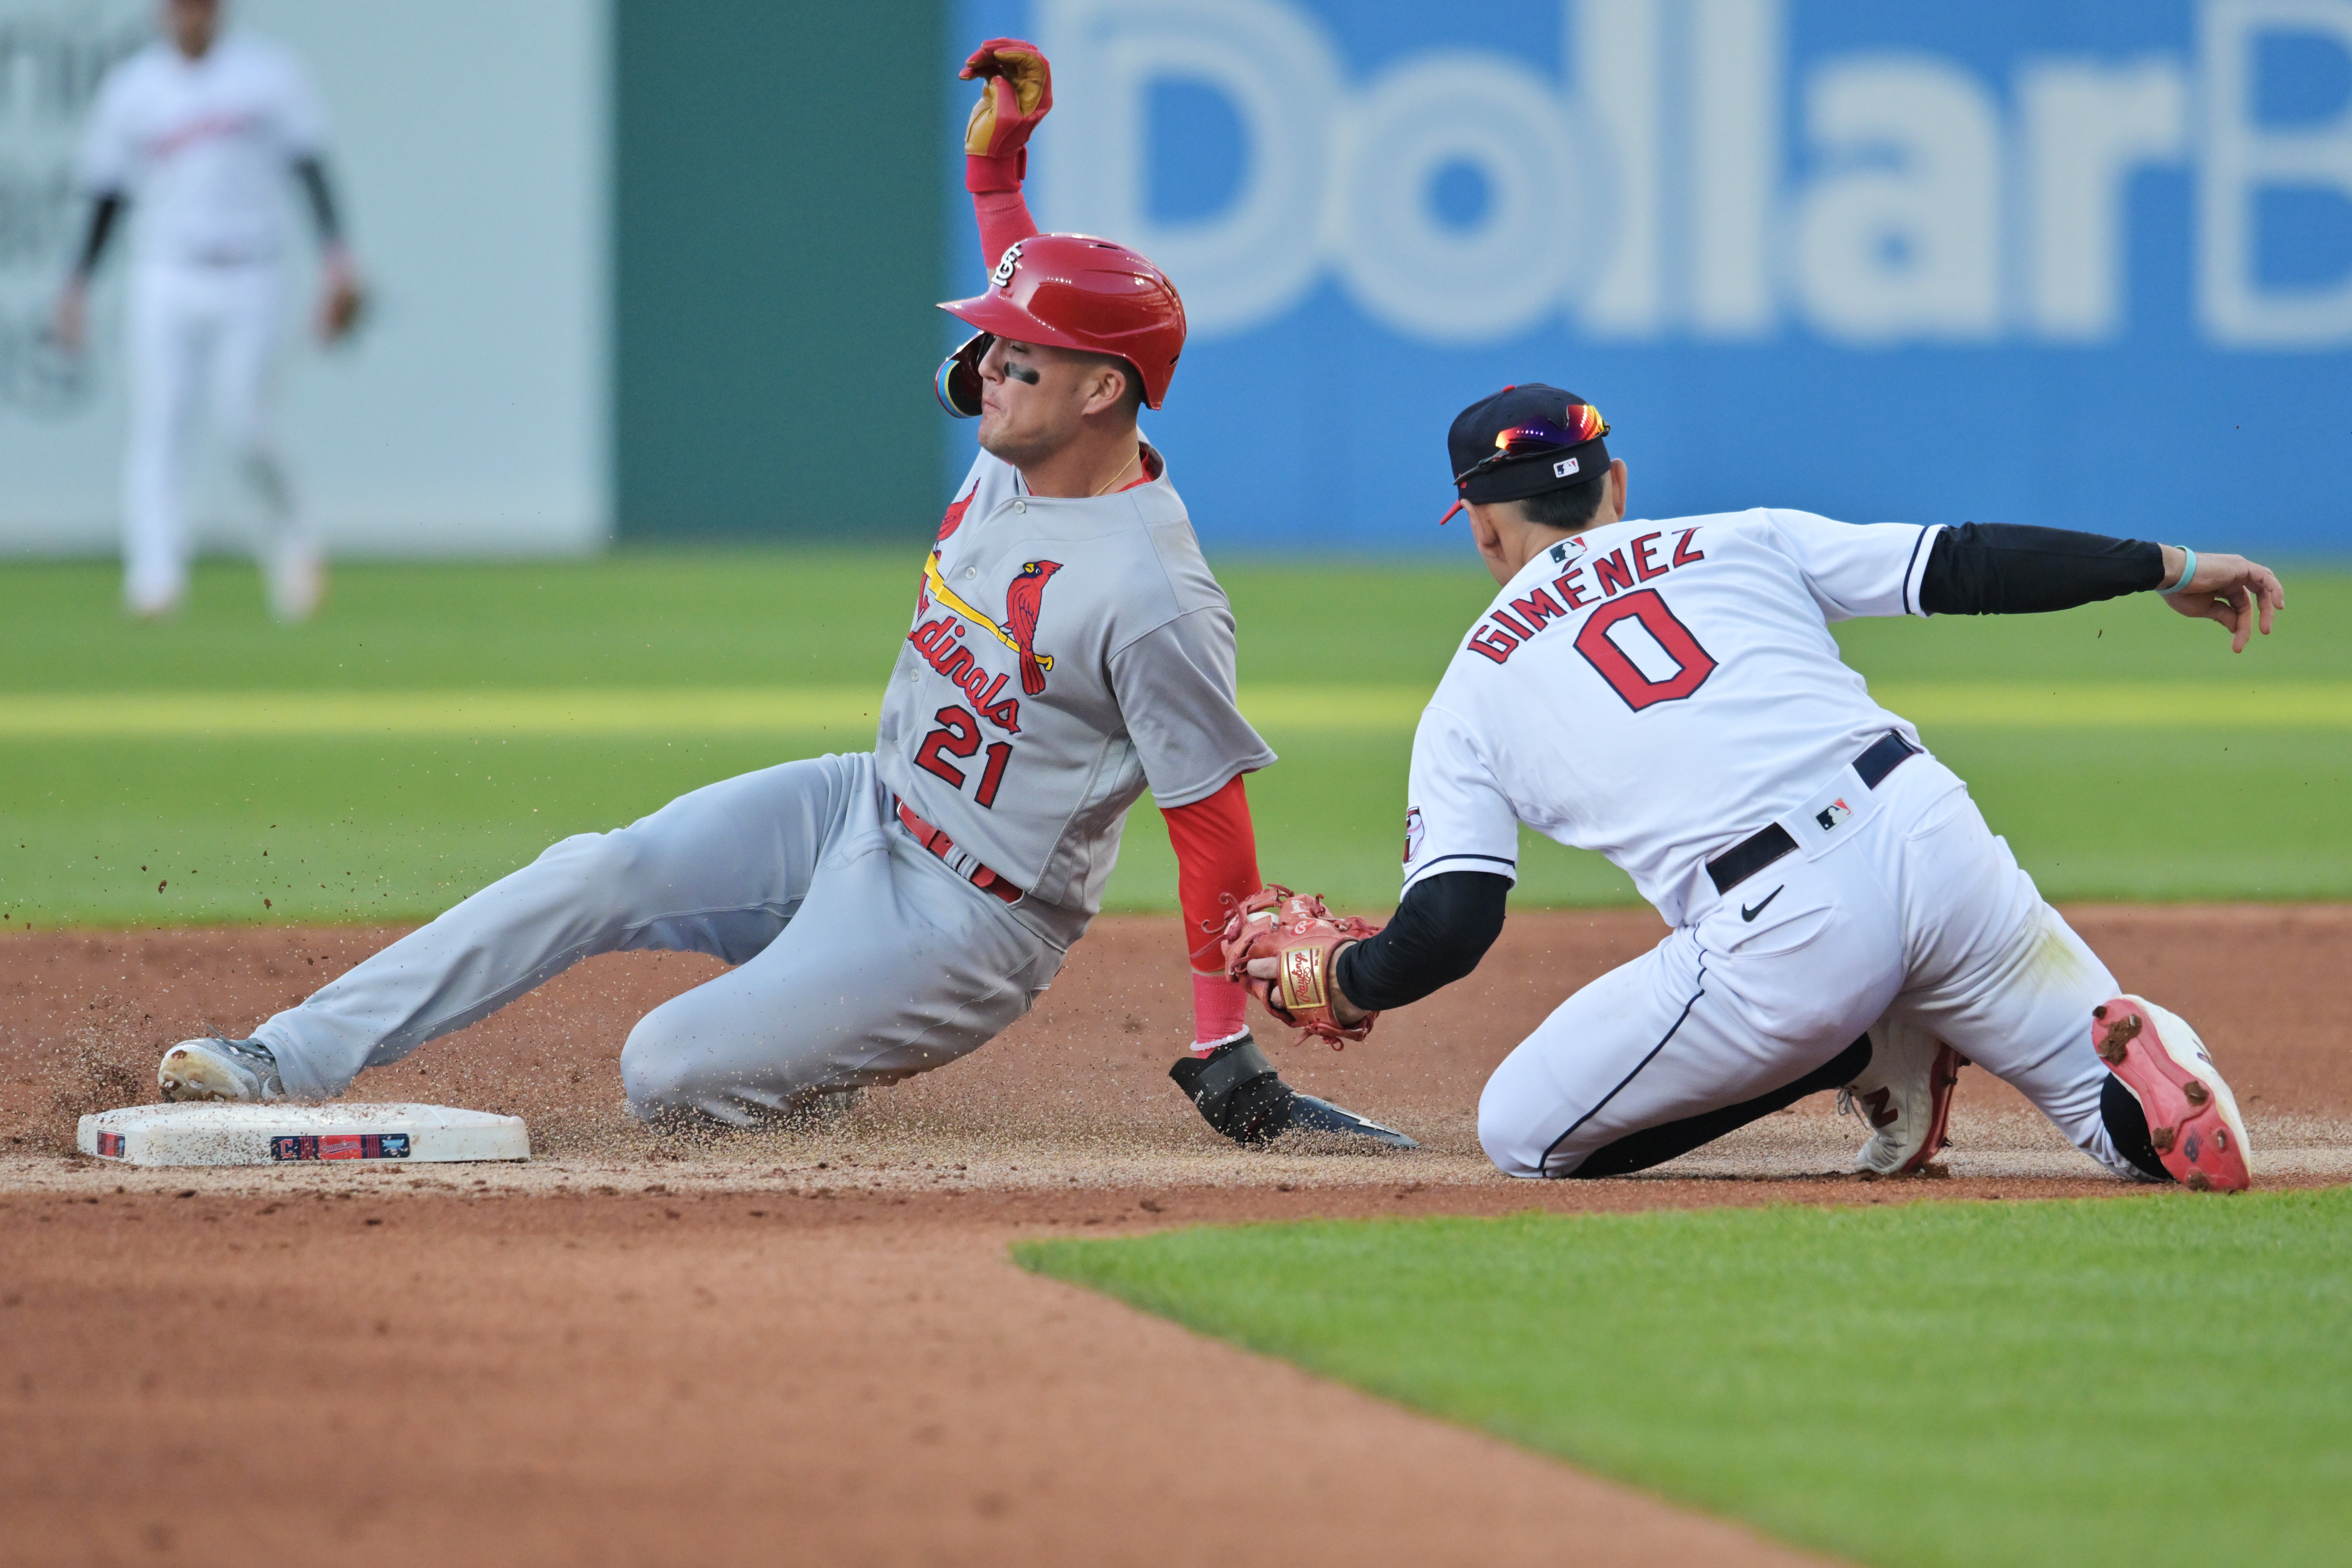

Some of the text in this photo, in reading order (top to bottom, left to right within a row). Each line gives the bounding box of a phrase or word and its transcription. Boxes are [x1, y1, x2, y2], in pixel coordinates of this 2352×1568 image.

[1466, 526, 1705, 665] GIMÉNEZ
[1572, 588, 1720, 713] 0
[913, 704, 1014, 810] 21
